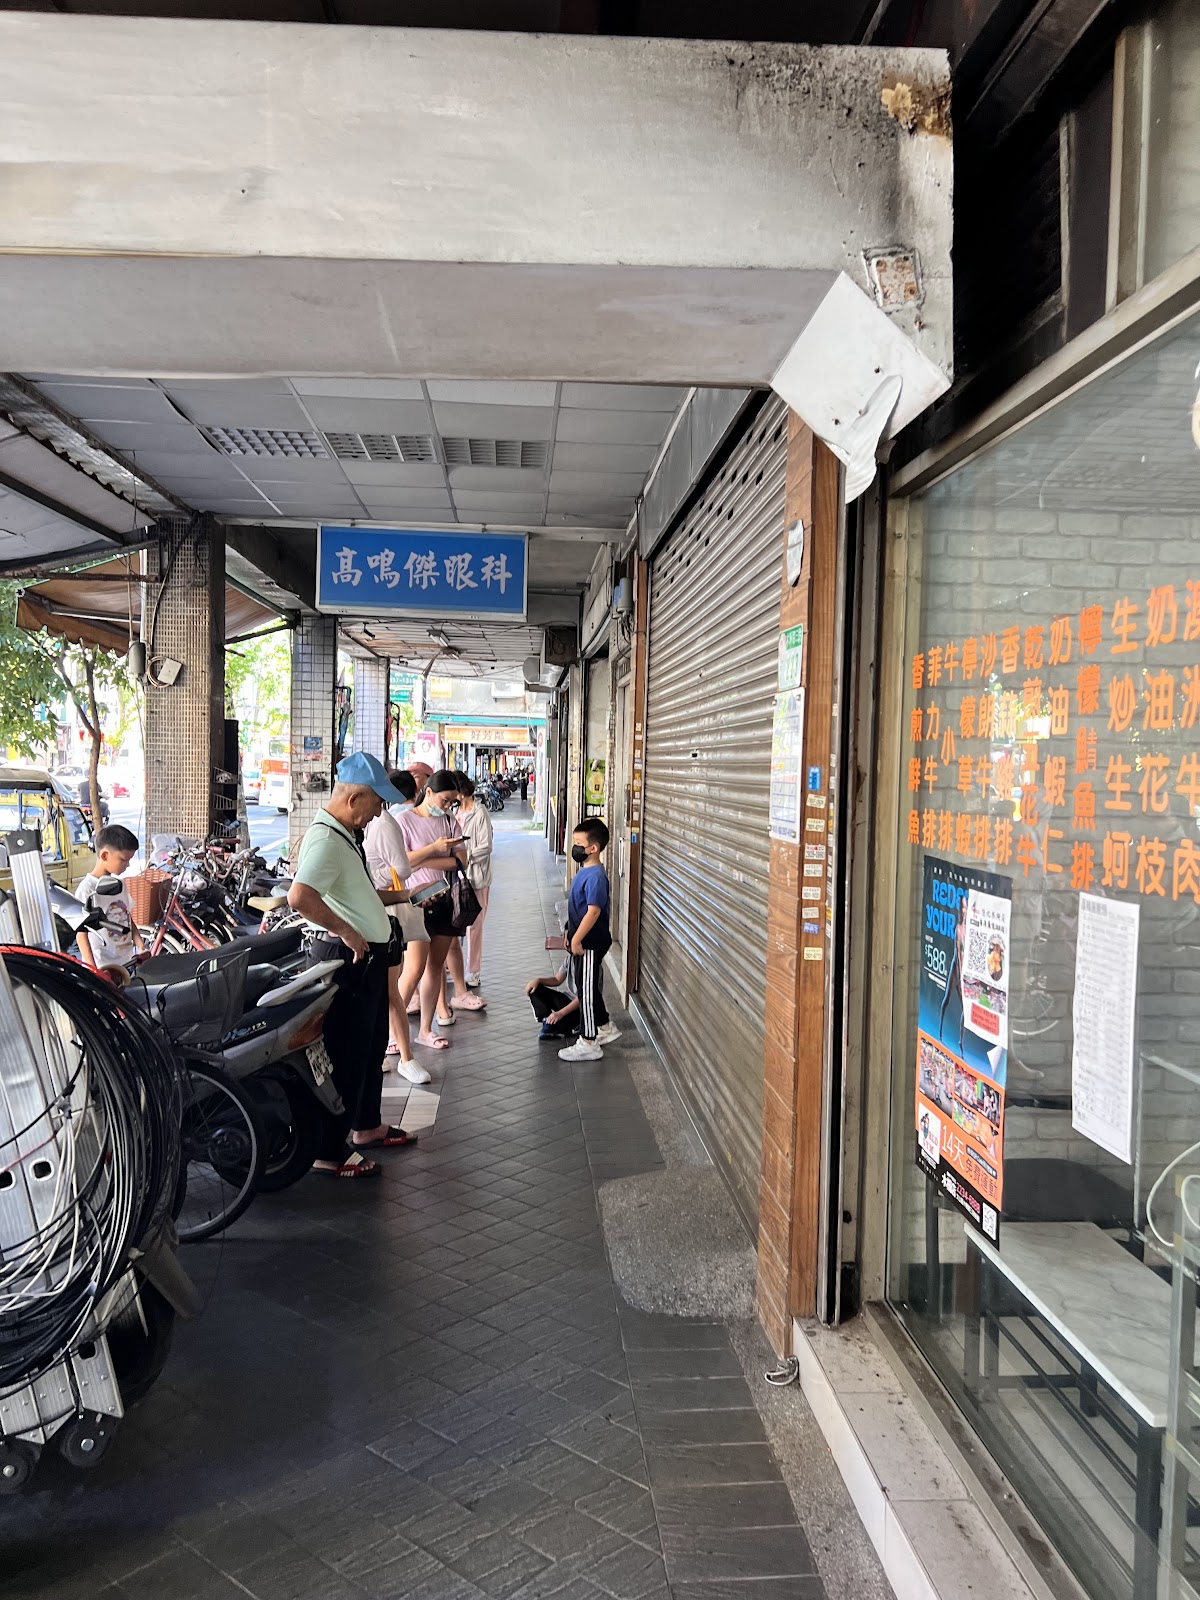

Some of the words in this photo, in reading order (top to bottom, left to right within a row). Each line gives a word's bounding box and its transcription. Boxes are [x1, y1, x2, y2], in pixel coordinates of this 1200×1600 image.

[922, 645, 943, 849] 菲力牛排
[938, 640, 959, 853] 牛小排
[955, 636, 978, 857] 檸檬草蝦
[974, 631, 998, 861] 沙朗牛排
[1042, 616, 1073, 874] 奶油蝦仁
[1070, 604, 1103, 891] 檸檬鯖魚排
[1101, 596, 1138, 889] 生炒生蚵
[1135, 584, 1178, 897] 奶油花枝
[925, 904, 956, 940] YOUR
[932, 879, 970, 911] REDE
[941, 1124, 965, 1171] 14天
